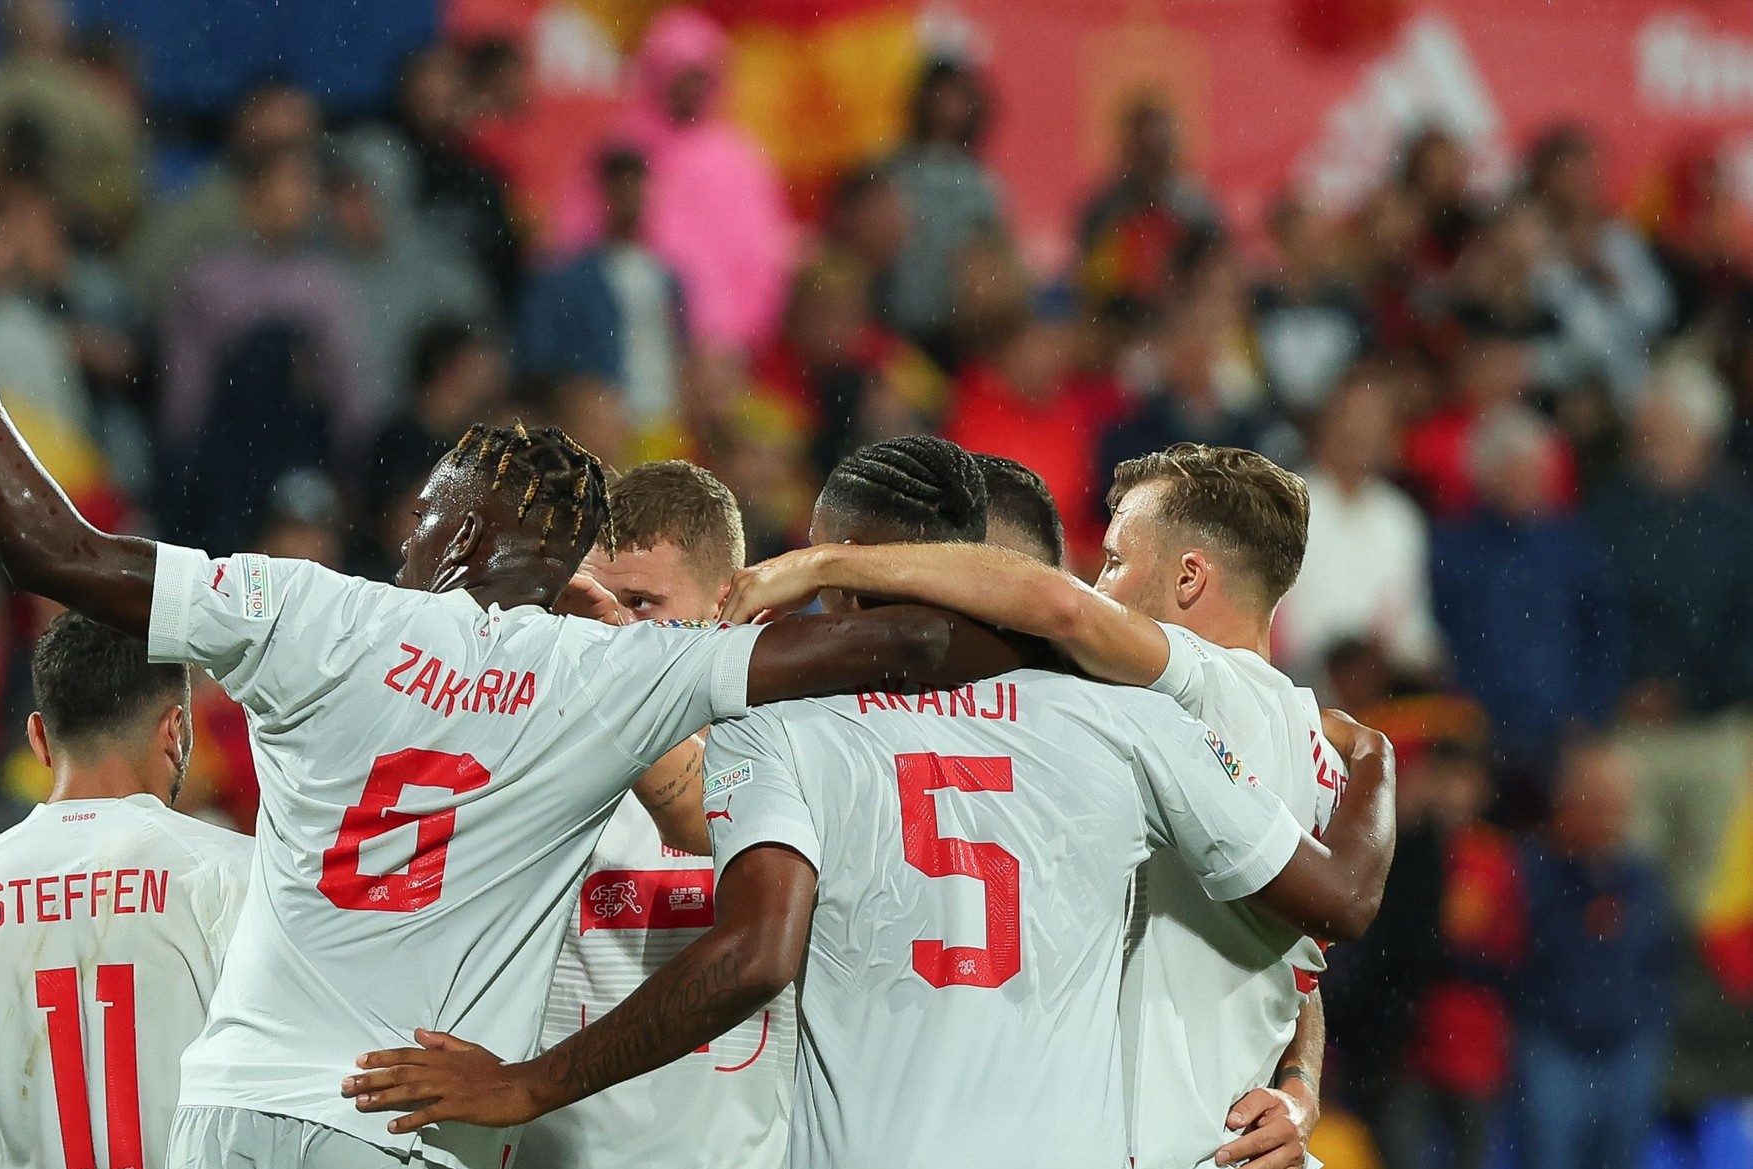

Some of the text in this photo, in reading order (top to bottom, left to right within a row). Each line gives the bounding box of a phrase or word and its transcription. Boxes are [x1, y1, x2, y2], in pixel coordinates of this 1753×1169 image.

[383, 642, 536, 718] ZAKRIA
[61, 811, 96, 822] suisse
[316, 747, 491, 913] 6
[895, 751, 1021, 989] 5
